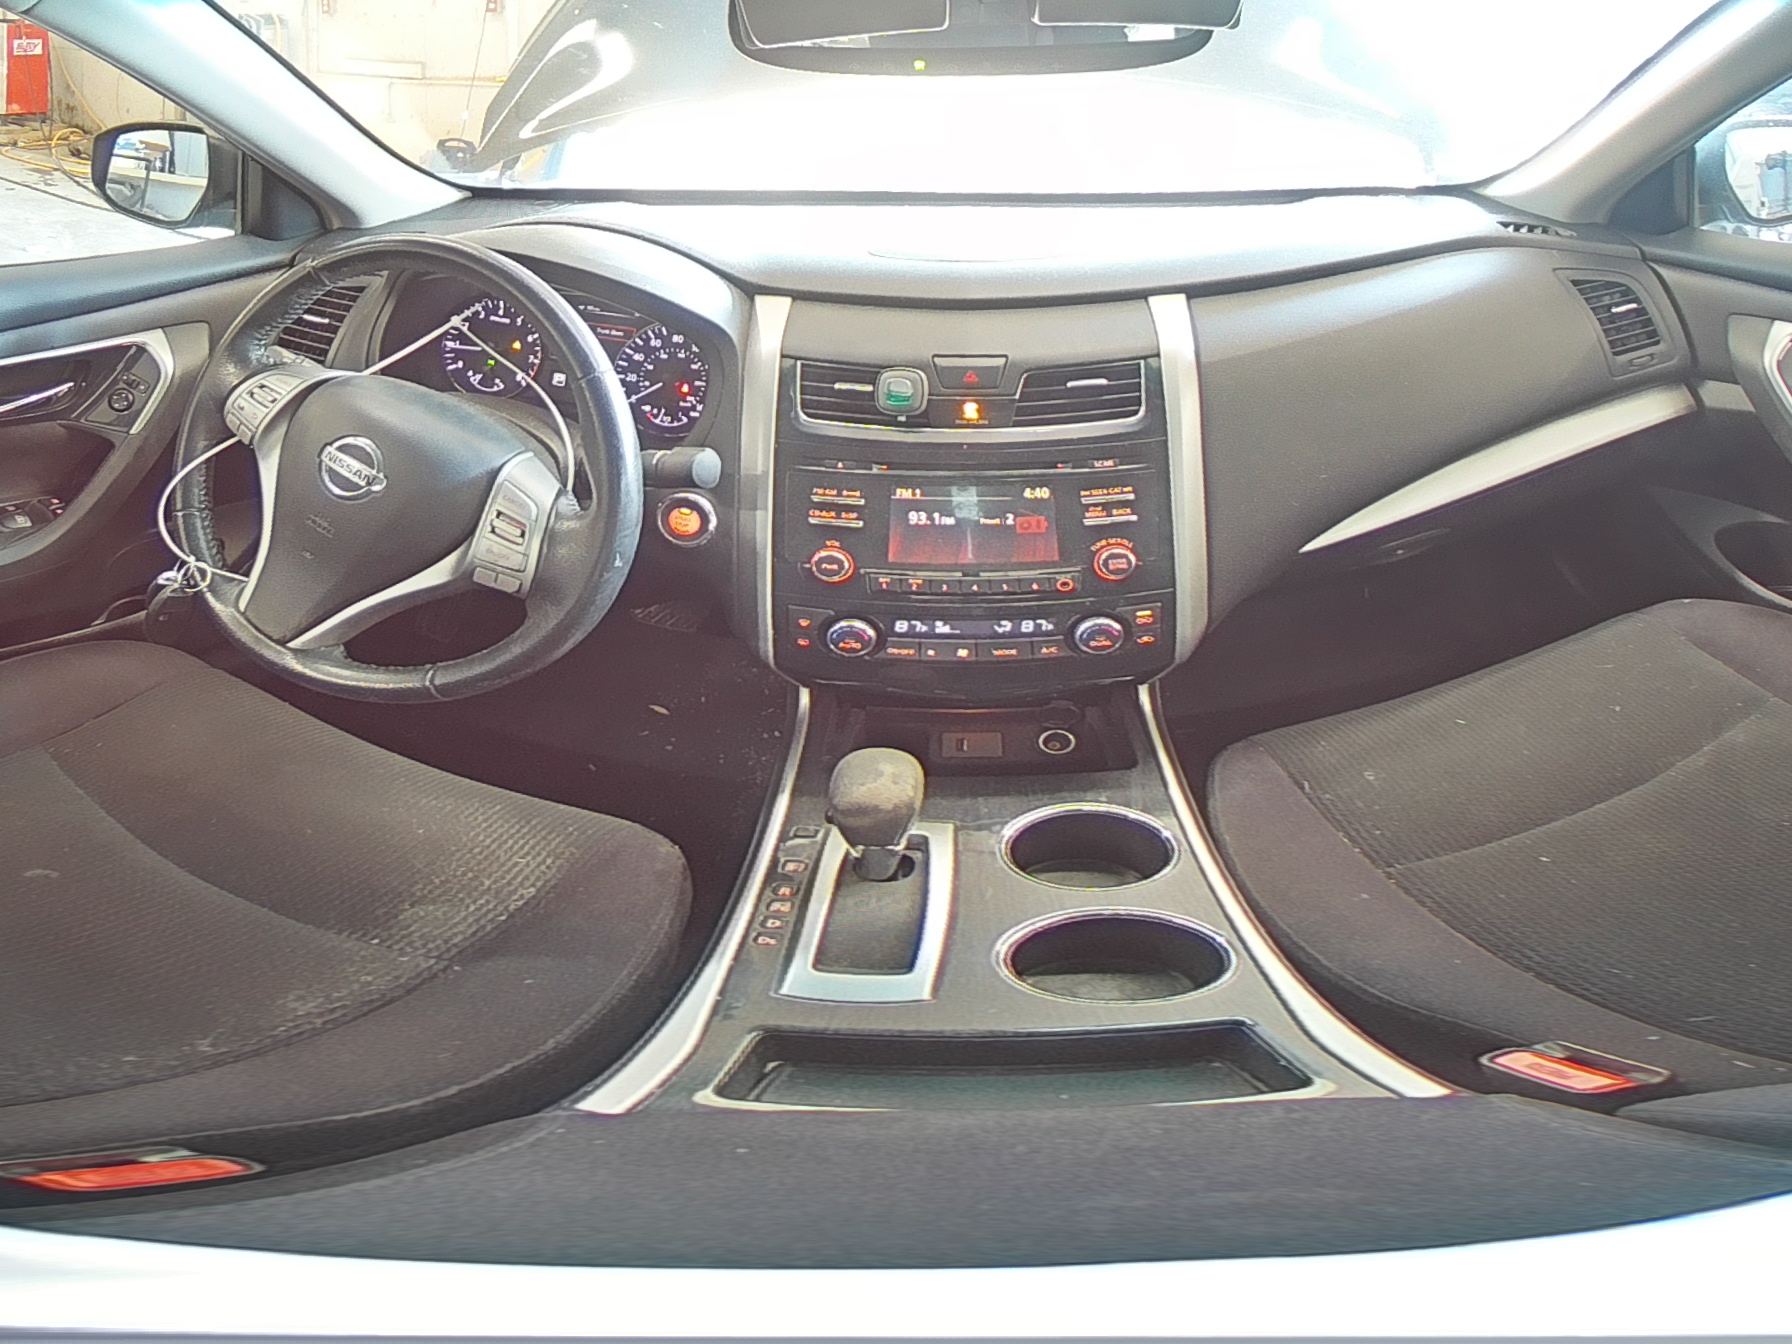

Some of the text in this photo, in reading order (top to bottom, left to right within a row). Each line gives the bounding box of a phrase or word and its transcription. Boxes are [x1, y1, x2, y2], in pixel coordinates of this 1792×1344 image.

[650, 339, 662, 347] 60
[672, 334, 684, 343] 80
[626, 373, 638, 382] 20
[324, 451, 376, 486] NISSAN
[896, 488, 912, 498] FM
[1023, 486, 1050, 499] 4:40
[908, 510, 940, 525] 93.1
[1005, 512, 1015, 525] 2
